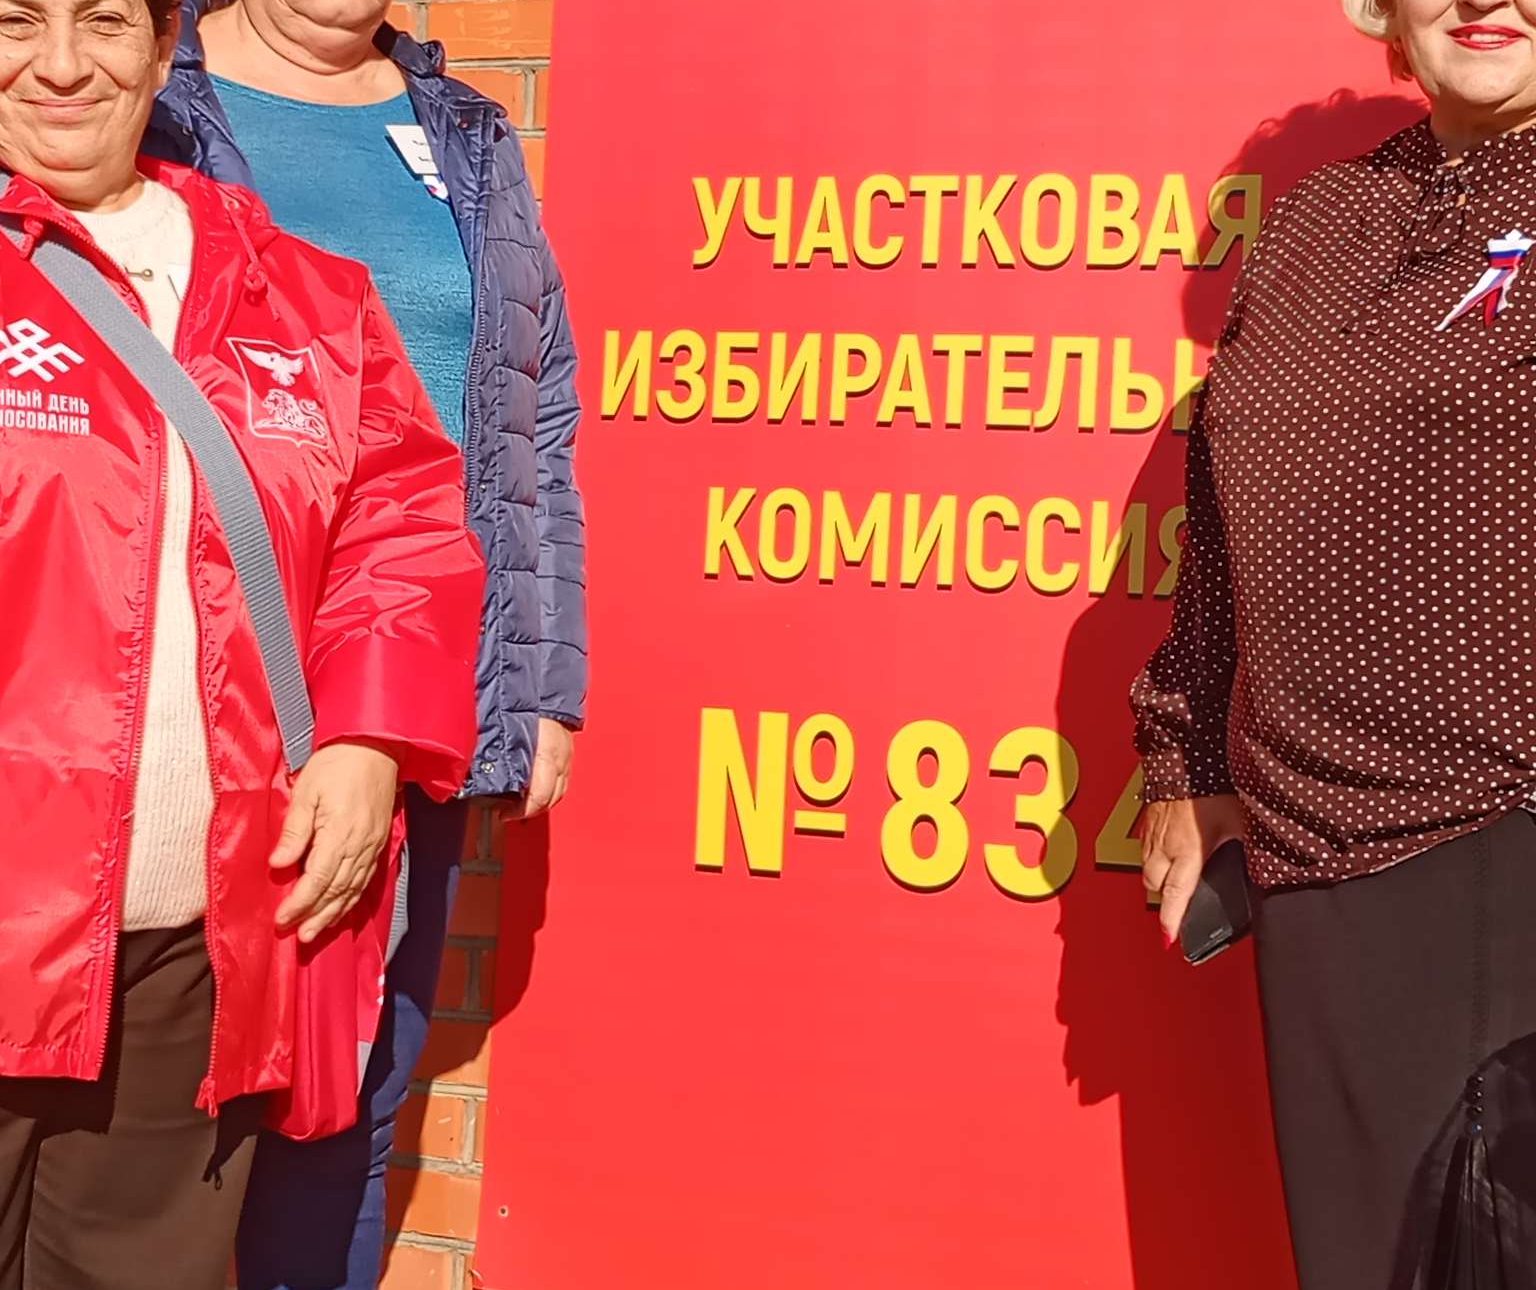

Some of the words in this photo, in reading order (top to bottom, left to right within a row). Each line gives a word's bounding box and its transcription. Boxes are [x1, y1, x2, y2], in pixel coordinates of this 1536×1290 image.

[692, 173, 1262, 268] УЧАСТКОВАЯ
[48, 394, 90, 415] ДЕНЬ
[601, 329, 1221, 431] ИЗБИРАТЕЛЬН
